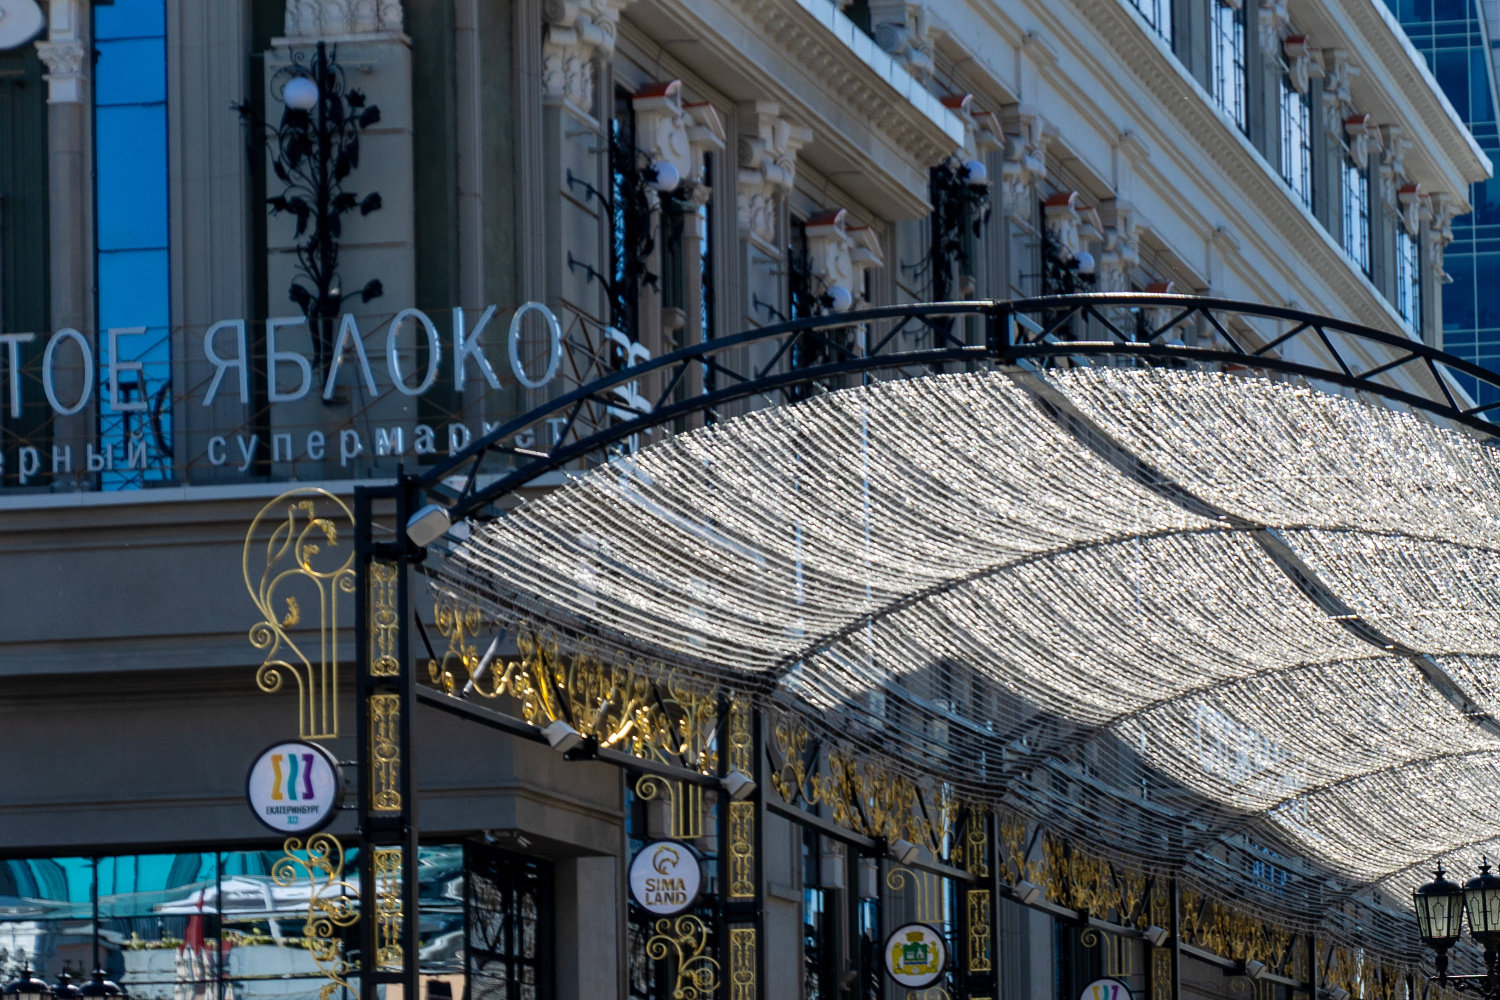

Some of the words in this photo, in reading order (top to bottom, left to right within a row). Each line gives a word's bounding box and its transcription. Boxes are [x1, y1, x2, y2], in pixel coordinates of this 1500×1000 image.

[202, 300, 563, 407] ЯБЛОКО
[0, 430, 148, 485] рный
[266, 804, 320, 815] ЕКАТЕРИНБУРГ
[644, 878, 687, 892] SIMA
[644, 891, 688, 906] LAND
